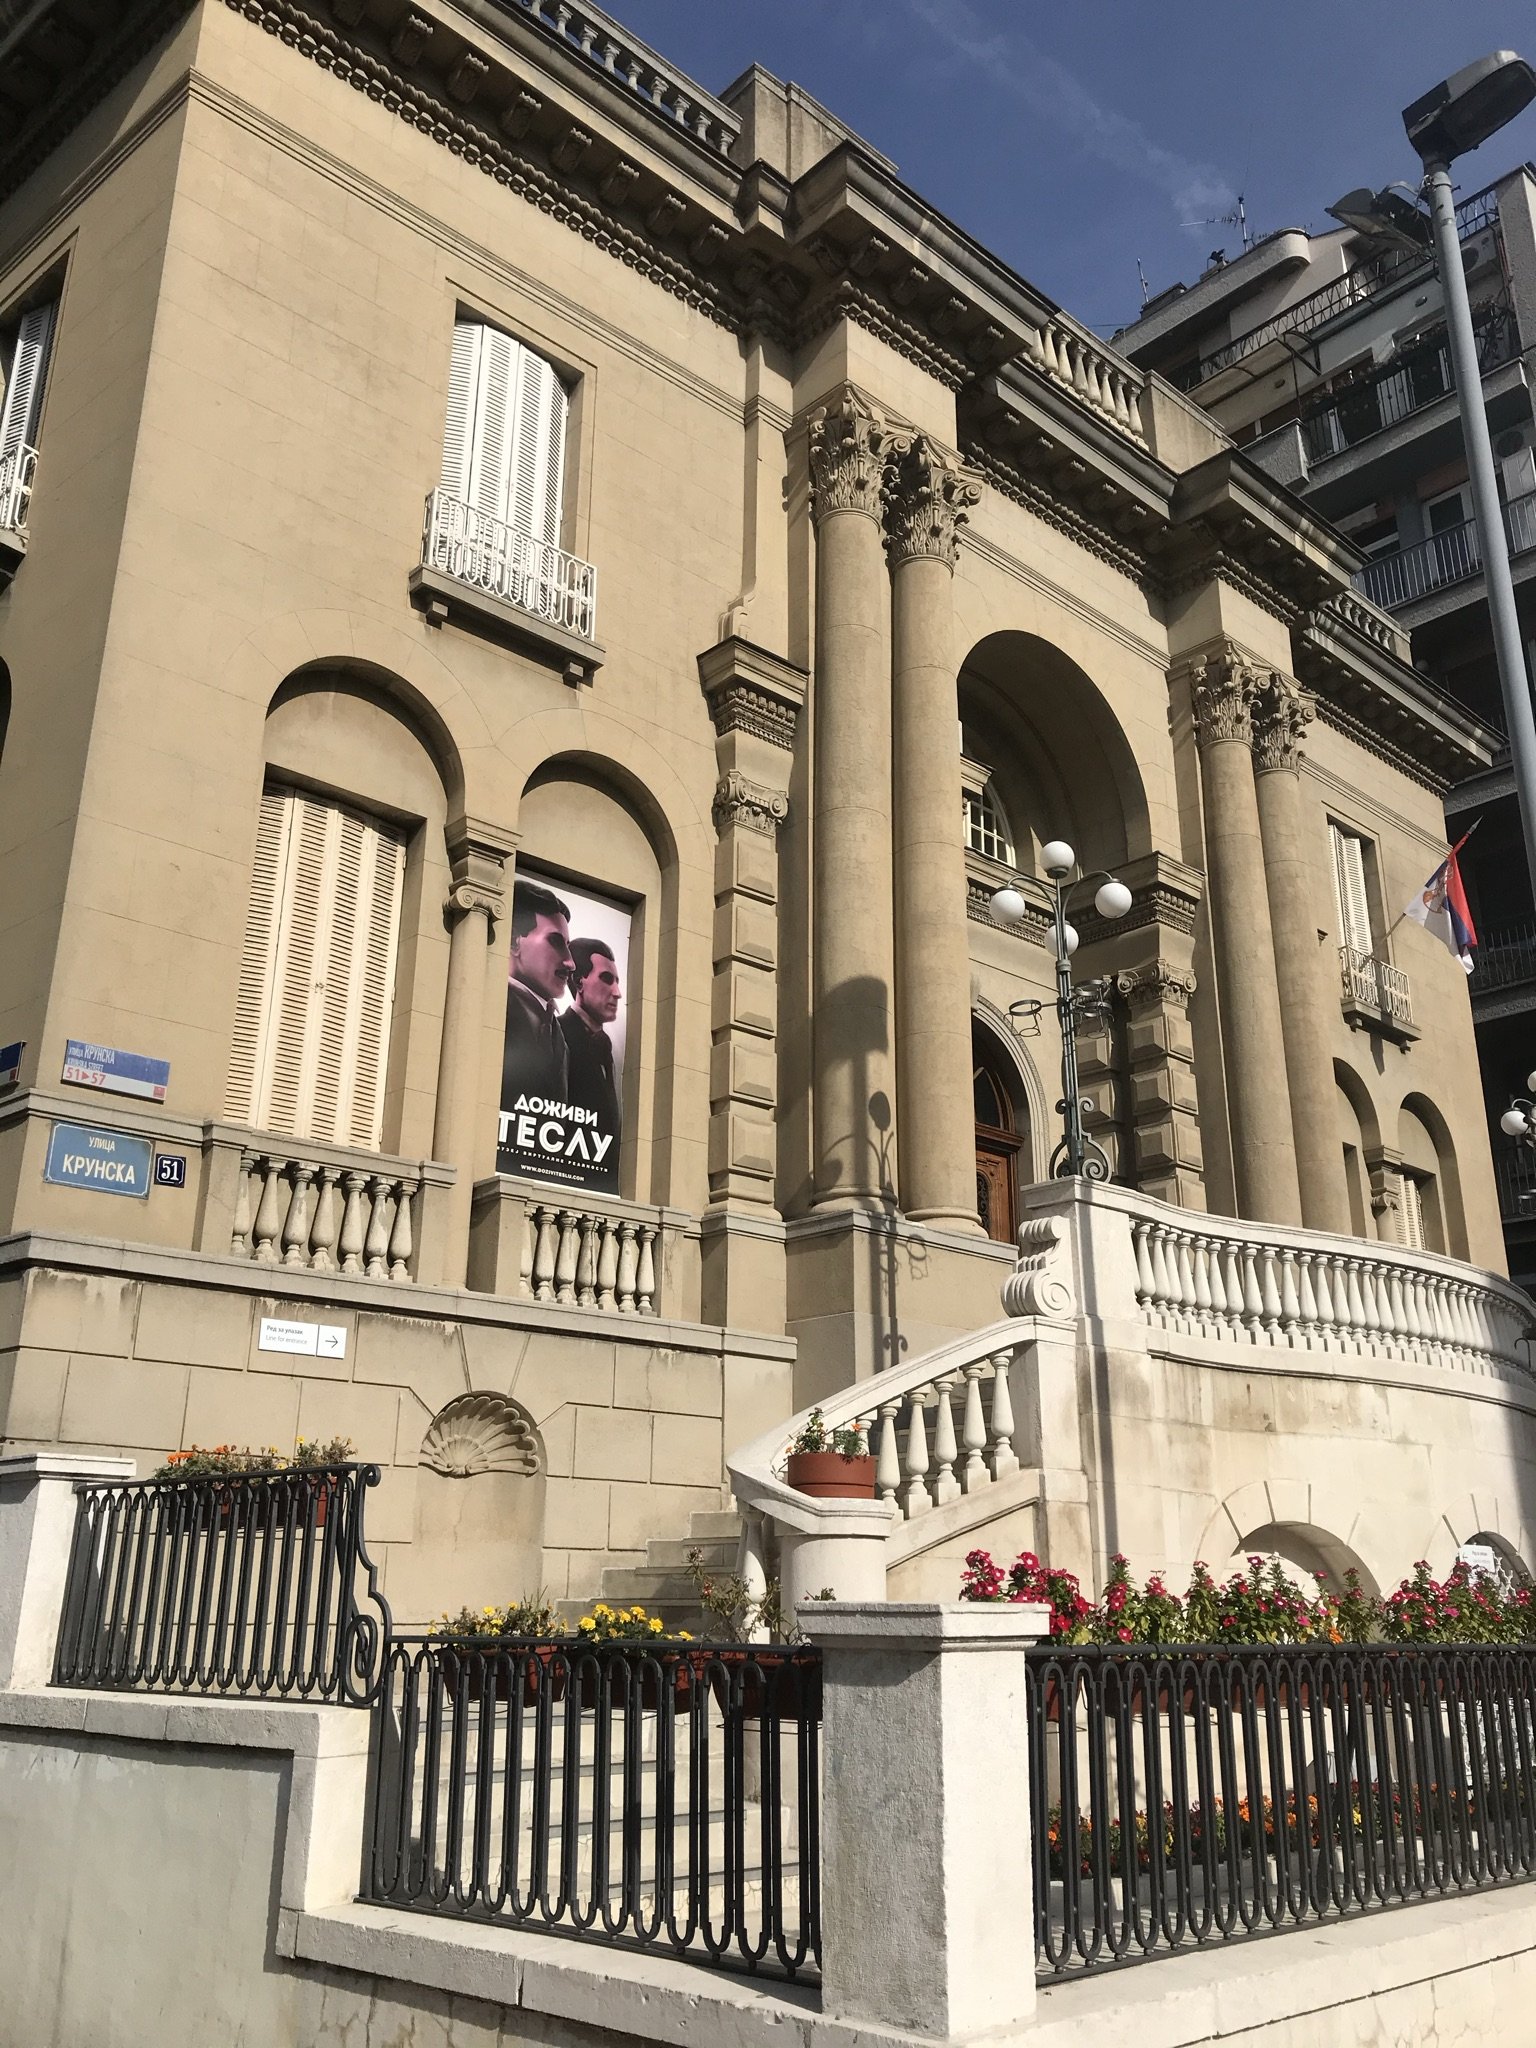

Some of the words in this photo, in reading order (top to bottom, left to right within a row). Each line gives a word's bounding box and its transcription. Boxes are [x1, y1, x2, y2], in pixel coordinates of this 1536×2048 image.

[84, 1044, 115, 1065] КРУНСКА
[514, 1093, 598, 1127] ДОЖИВИ
[88, 1136, 115, 1152] УЛИЦА
[499, 1110, 613, 1163] ТЕСЛУ
[62, 1154, 135, 1184] КРУНСКА
[161, 1160, 180, 1182] 51
